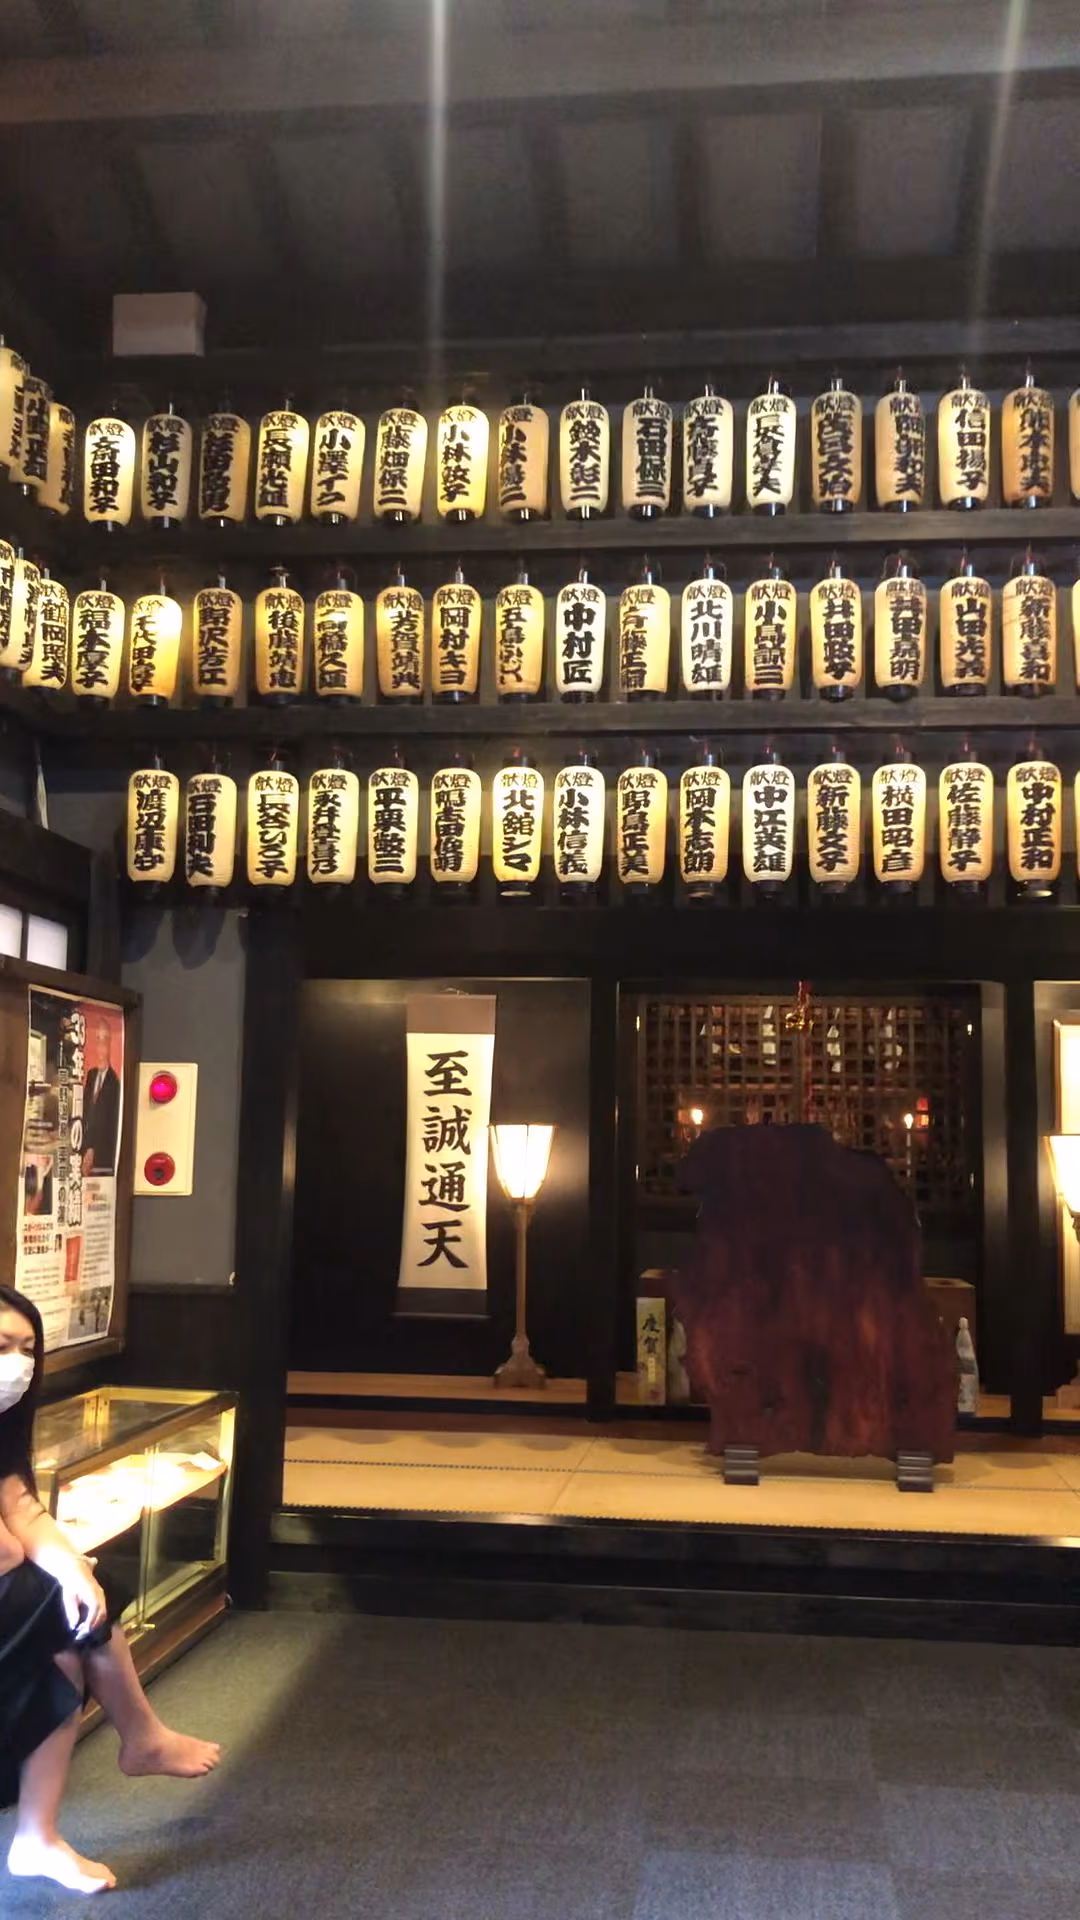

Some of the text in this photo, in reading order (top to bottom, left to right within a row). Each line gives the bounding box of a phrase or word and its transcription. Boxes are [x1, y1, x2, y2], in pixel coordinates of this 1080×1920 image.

[437, 588, 475, 607] 献燈
[560, 588, 601, 604] 献燈
[686, 583, 728, 601] 献燈
[751, 583, 793, 601] 献燈
[264, 592, 302, 611] 献燈
[383, 592, 424, 611] 献燈
[438, 606, 470, 686] 岡村キヨ
[562, 603, 596, 685] 中村匠
[690, 600, 723, 685] 北川晴雄
[133, 774, 172, 792] 献燈
[254, 775, 295, 793] 献燈
[311, 774, 348, 793] 献燈
[370, 772, 412, 790] 献燈
[433, 774, 471, 790] 献燈
[619, 771, 658, 789] 献燈
[683, 770, 722, 788] 献燈
[750, 770, 791, 787] 献燈
[813, 768, 854, 785] 献燈
[944, 768, 985, 785] 献燈
[1015, 767, 1058, 784] 献燈
[752, 785, 788, 873] 中江英雄
[815, 783, 850, 873] 新藤文子
[881, 784, 914, 874] 横田昭彦
[1020, 781, 1056, 871] 中村正和
[255, 793, 291, 879] 長谷ひろ子
[417, 1049, 472, 1270] 至誠通天
